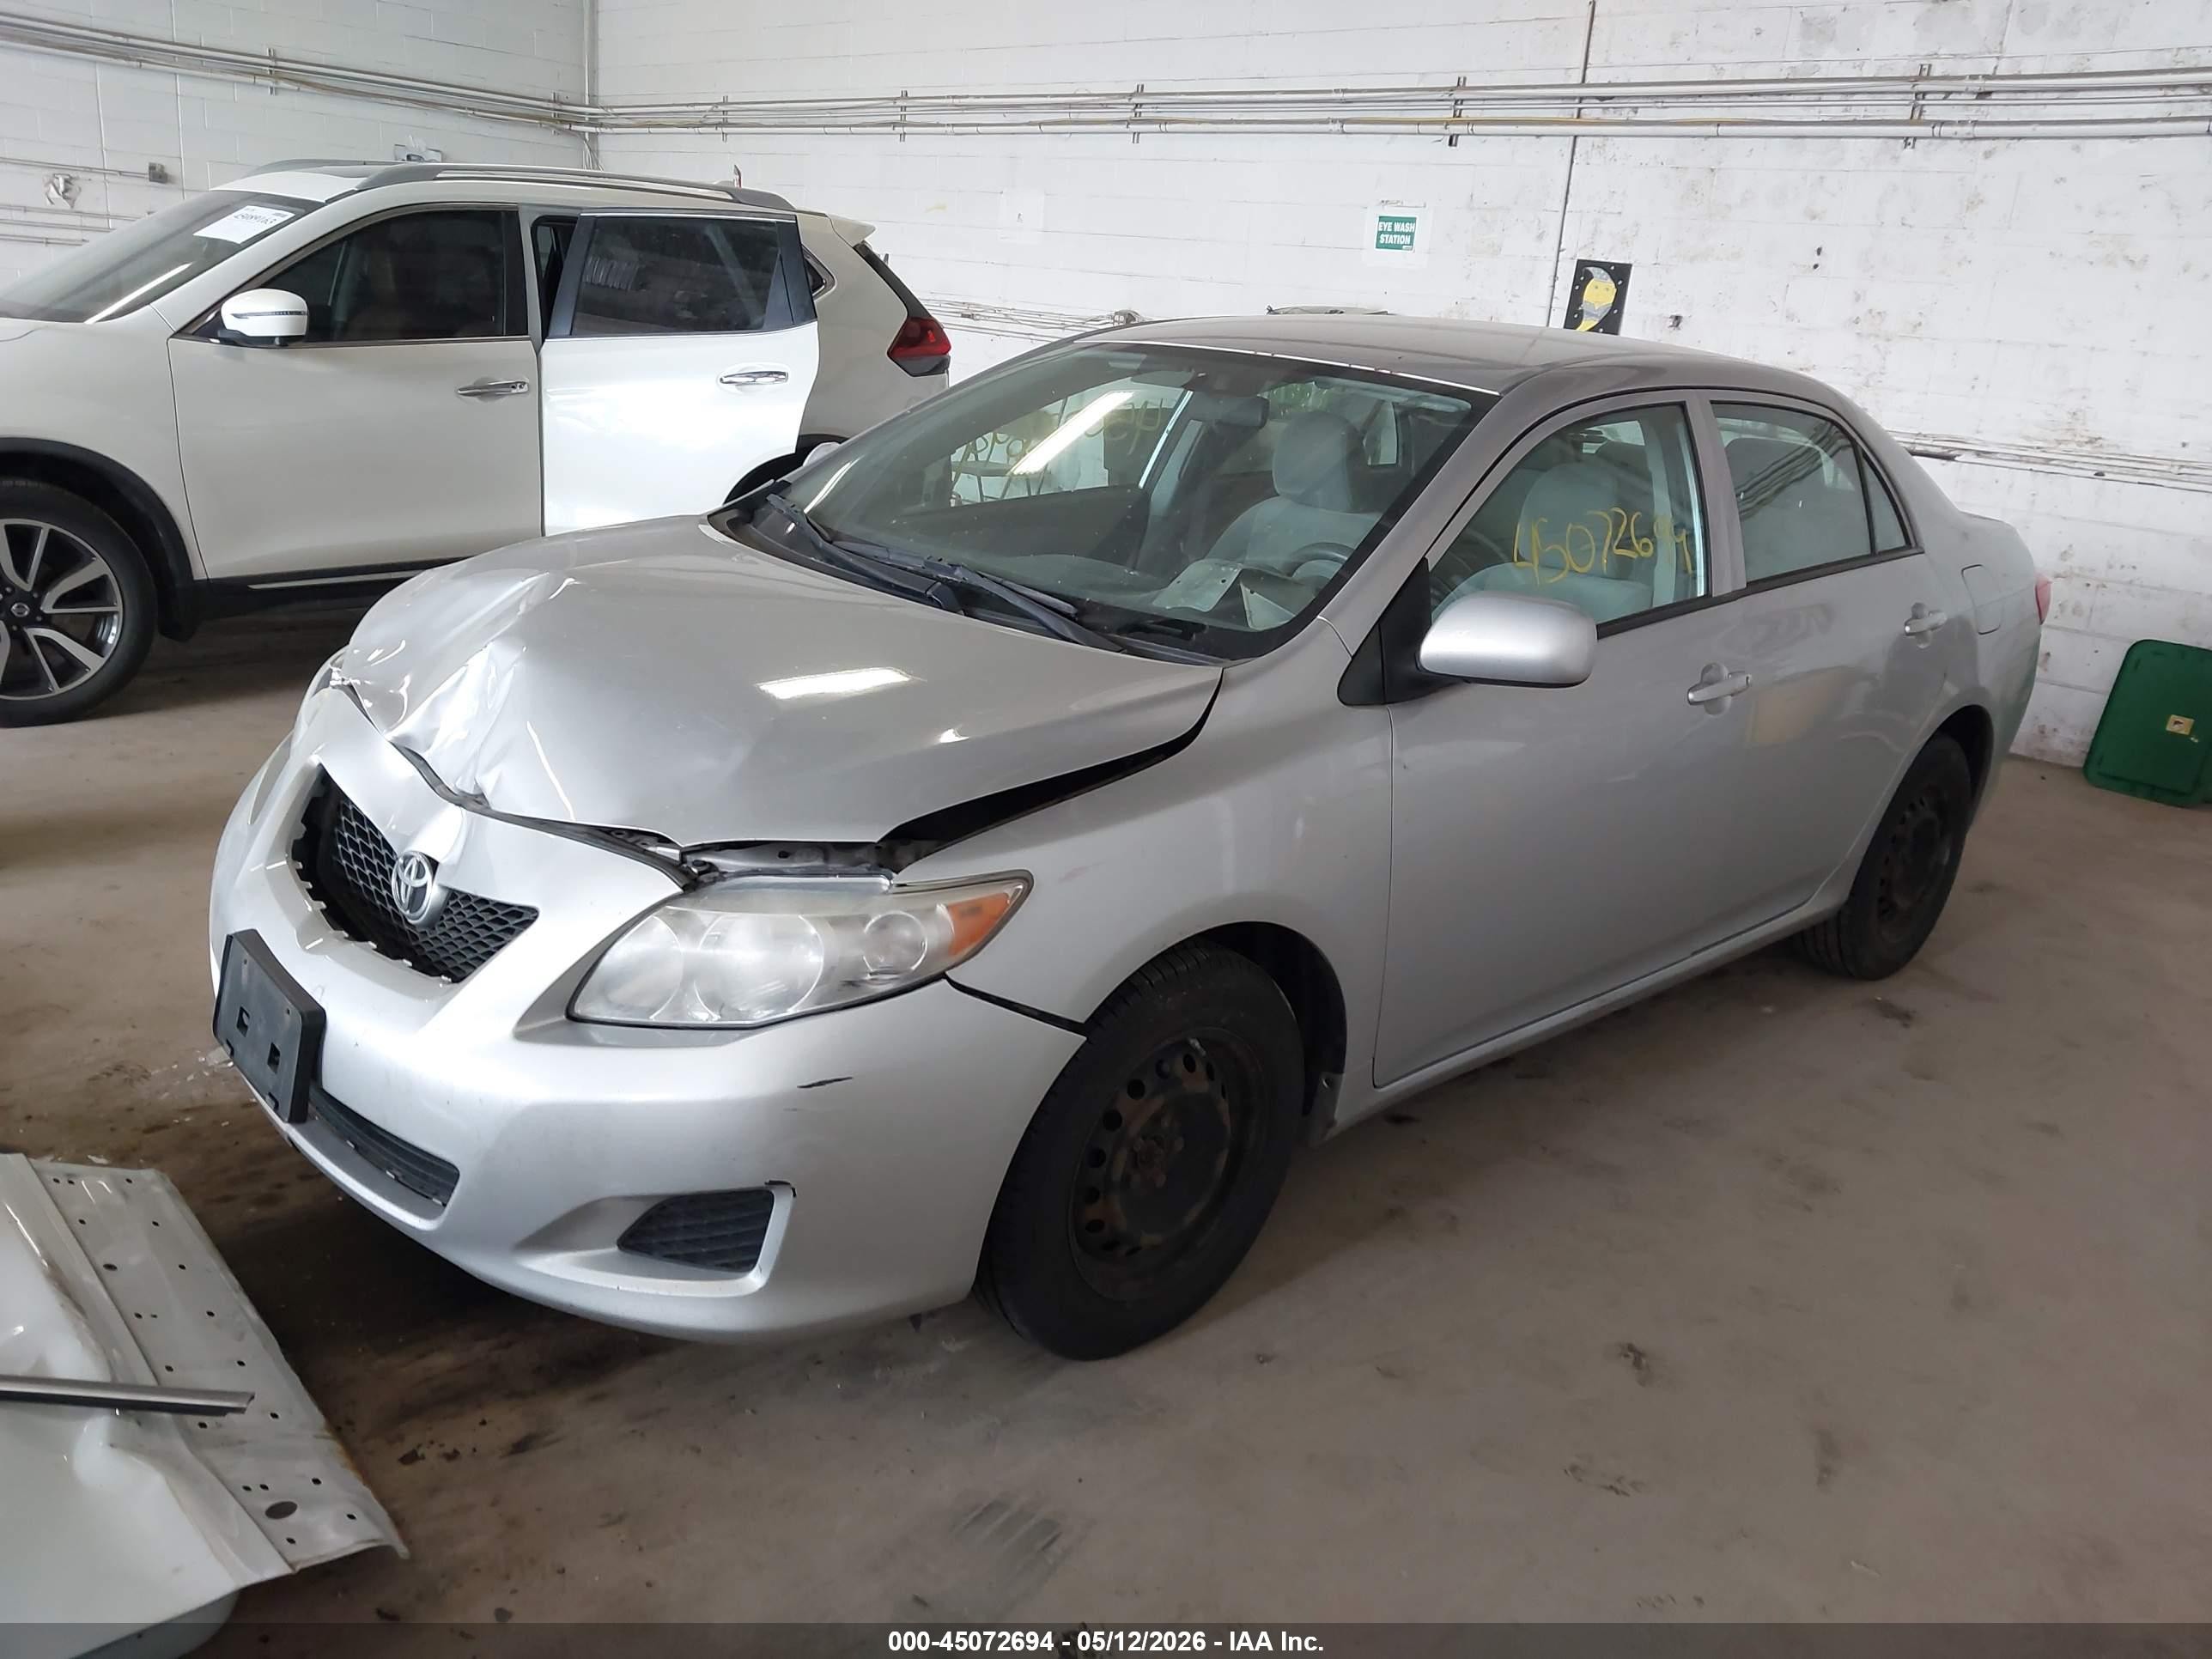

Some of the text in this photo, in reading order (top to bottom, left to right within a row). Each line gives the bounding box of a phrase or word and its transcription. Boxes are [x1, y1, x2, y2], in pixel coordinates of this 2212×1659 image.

[1378, 222, 1415, 233] EYE WASH
[1379, 233, 1411, 245] STATION
